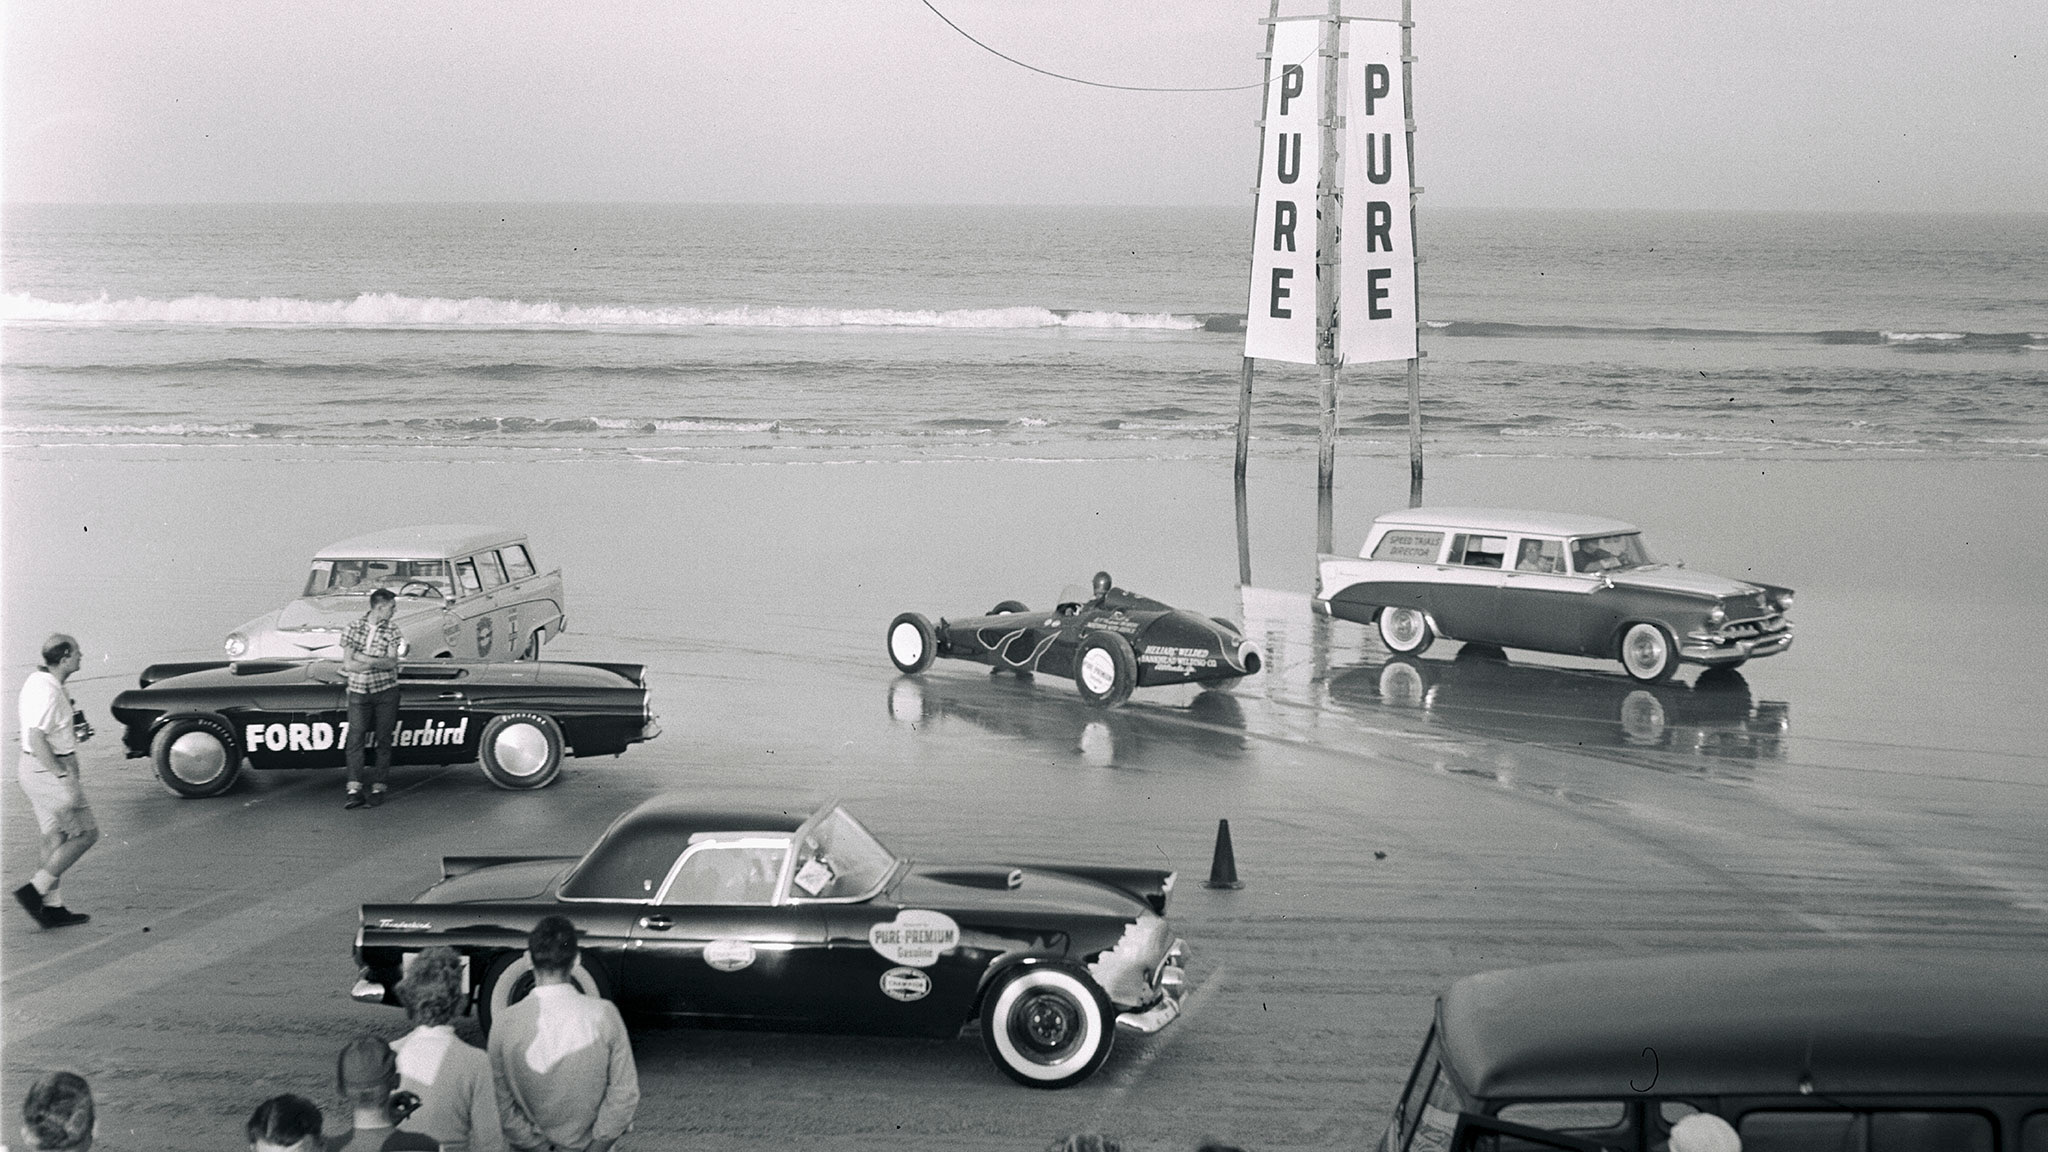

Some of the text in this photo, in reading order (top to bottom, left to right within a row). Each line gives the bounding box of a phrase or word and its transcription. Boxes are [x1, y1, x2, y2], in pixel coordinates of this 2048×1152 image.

[1270, 63, 1304, 319] PURE
[1364, 63, 1394, 320] PURE
[245, 722, 334, 752] FORD
[875, 929, 954, 944] PURE PREMIUM
